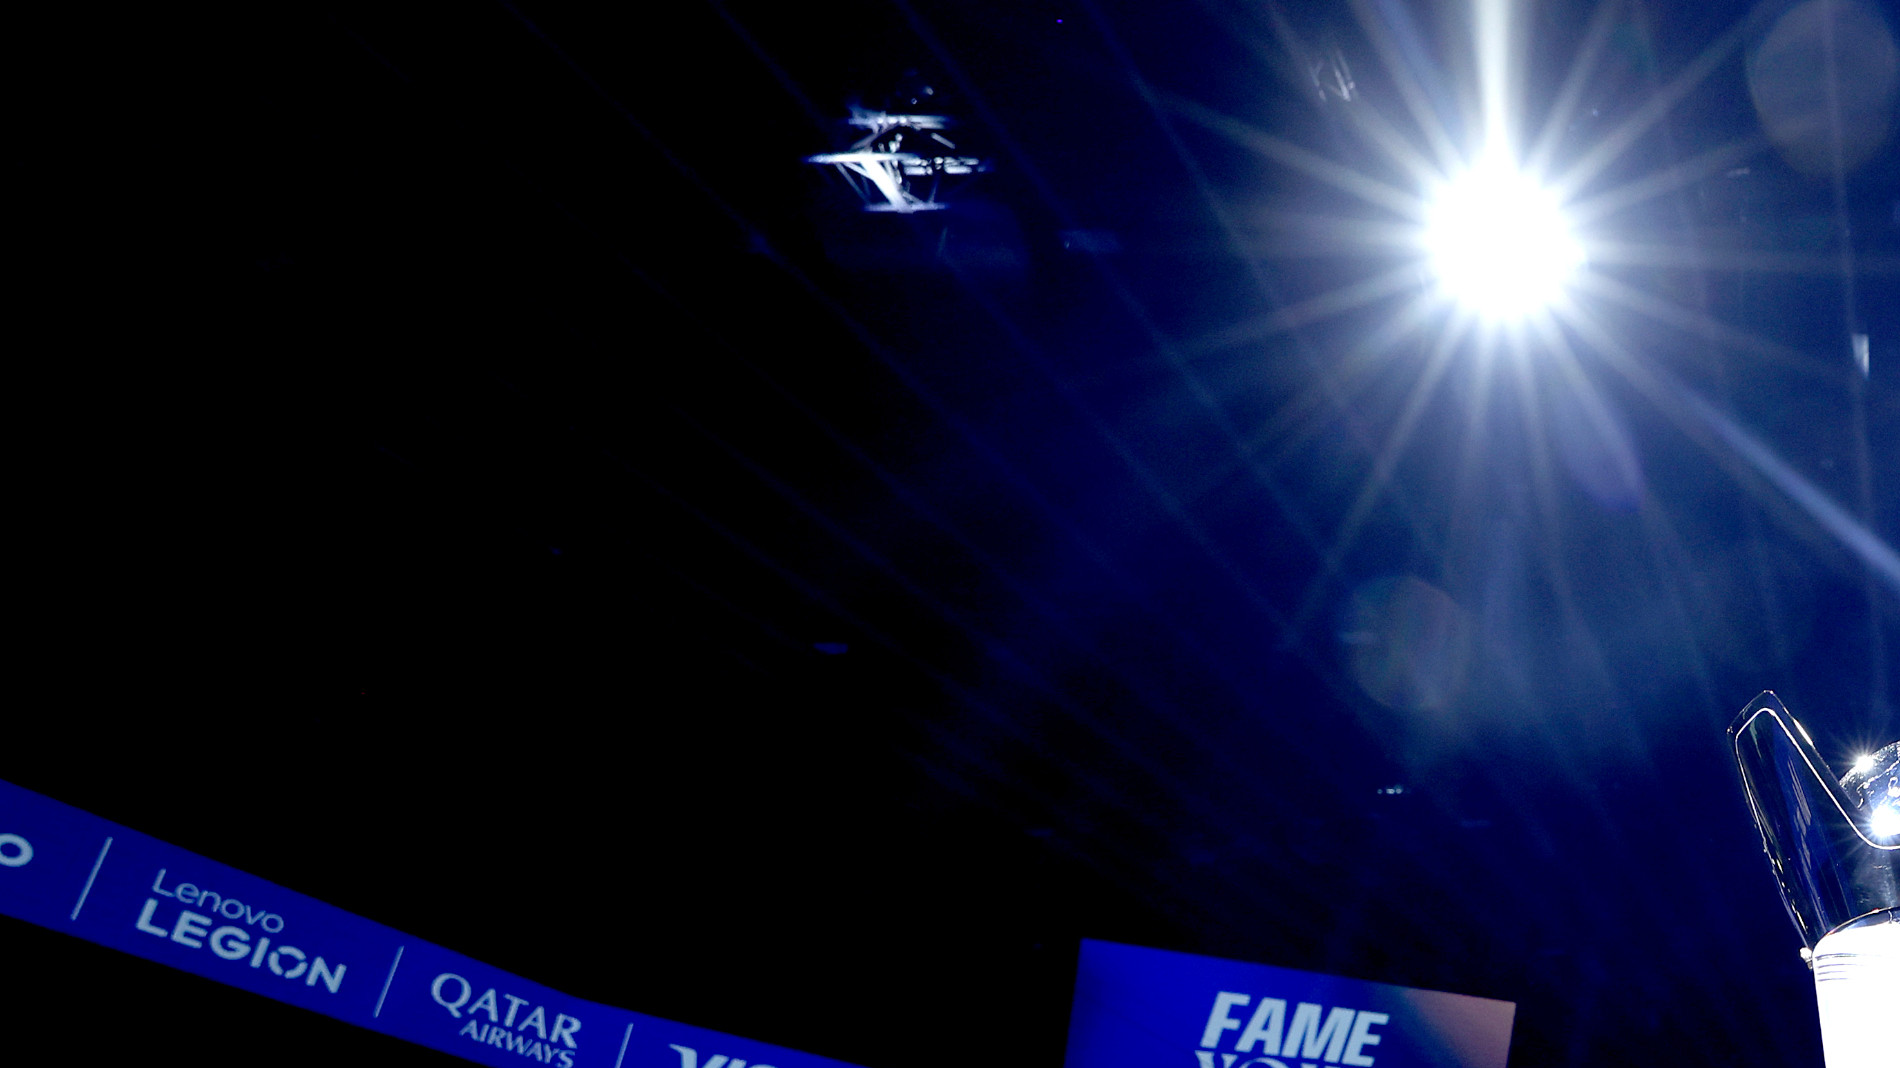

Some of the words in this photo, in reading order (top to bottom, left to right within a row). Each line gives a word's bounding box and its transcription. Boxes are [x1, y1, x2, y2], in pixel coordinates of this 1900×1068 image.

[152, 868, 284, 934] Lenovo
[136, 897, 346, 994] LEGION
[430, 972, 582, 1049] QATAR
[1199, 990, 1390, 1068] FAME
